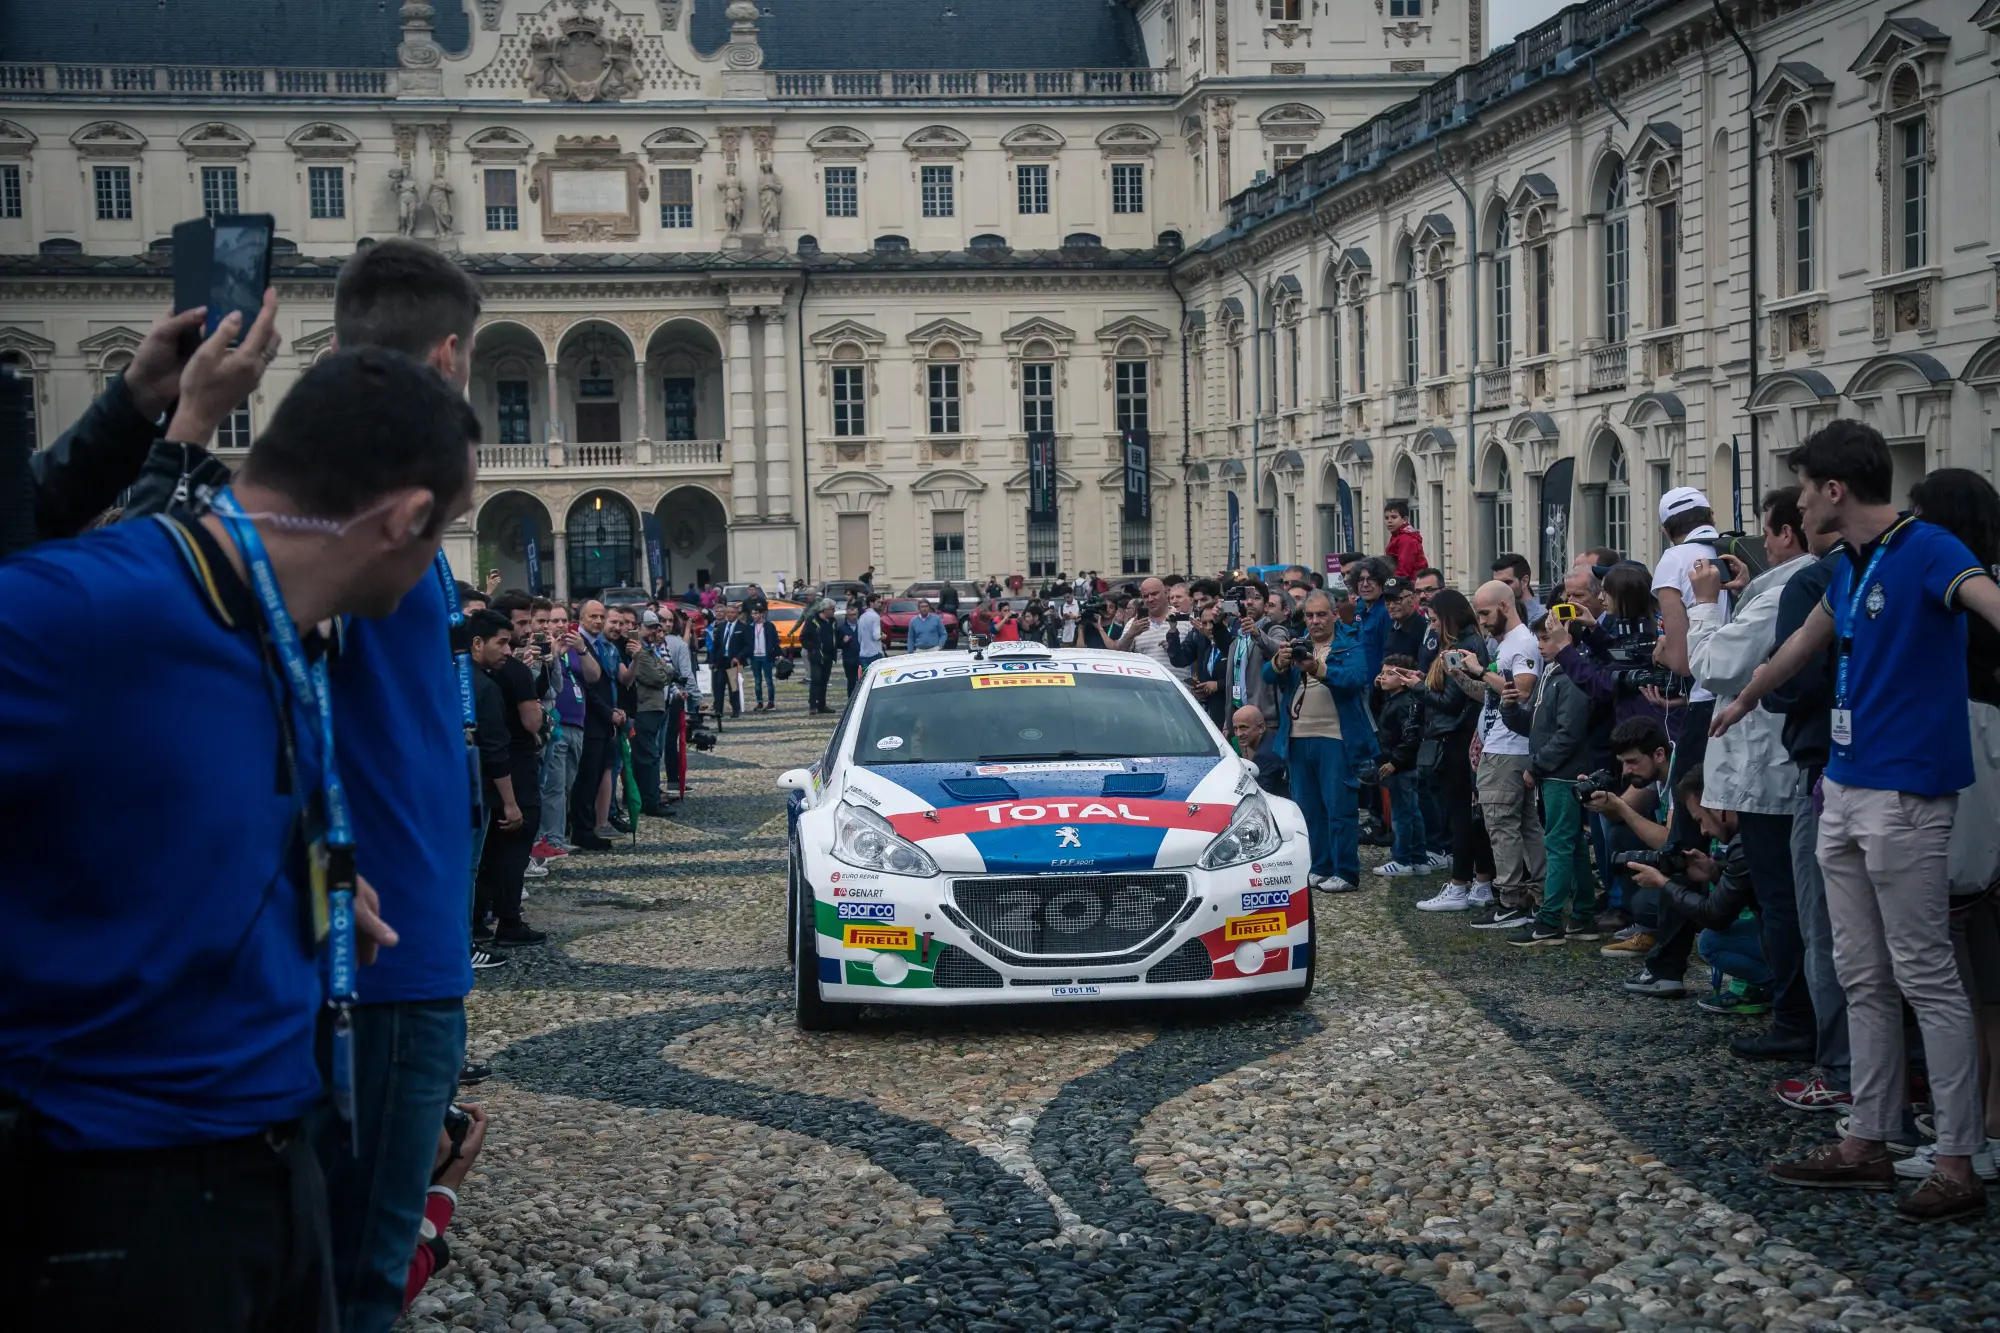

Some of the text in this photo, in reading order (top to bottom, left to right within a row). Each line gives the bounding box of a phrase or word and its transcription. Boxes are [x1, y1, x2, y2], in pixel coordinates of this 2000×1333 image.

[1127, 444, 1147, 495] 50
[943, 662, 1087, 677] SPORT
[1092, 663, 1151, 677] CIR
[979, 676, 1066, 686] PIRELLI
[975, 803, 1149, 823] TOTAL
[1264, 876, 1292, 886] GENART
[848, 888, 883, 898] GENART
[1243, 891, 1289, 909] sparco
[838, 903, 893, 919] sparco
[991, 888, 1156, 934] 208
[1231, 917, 1281, 936] PIRELLI
[850, 929, 908, 945] PIRELLI
